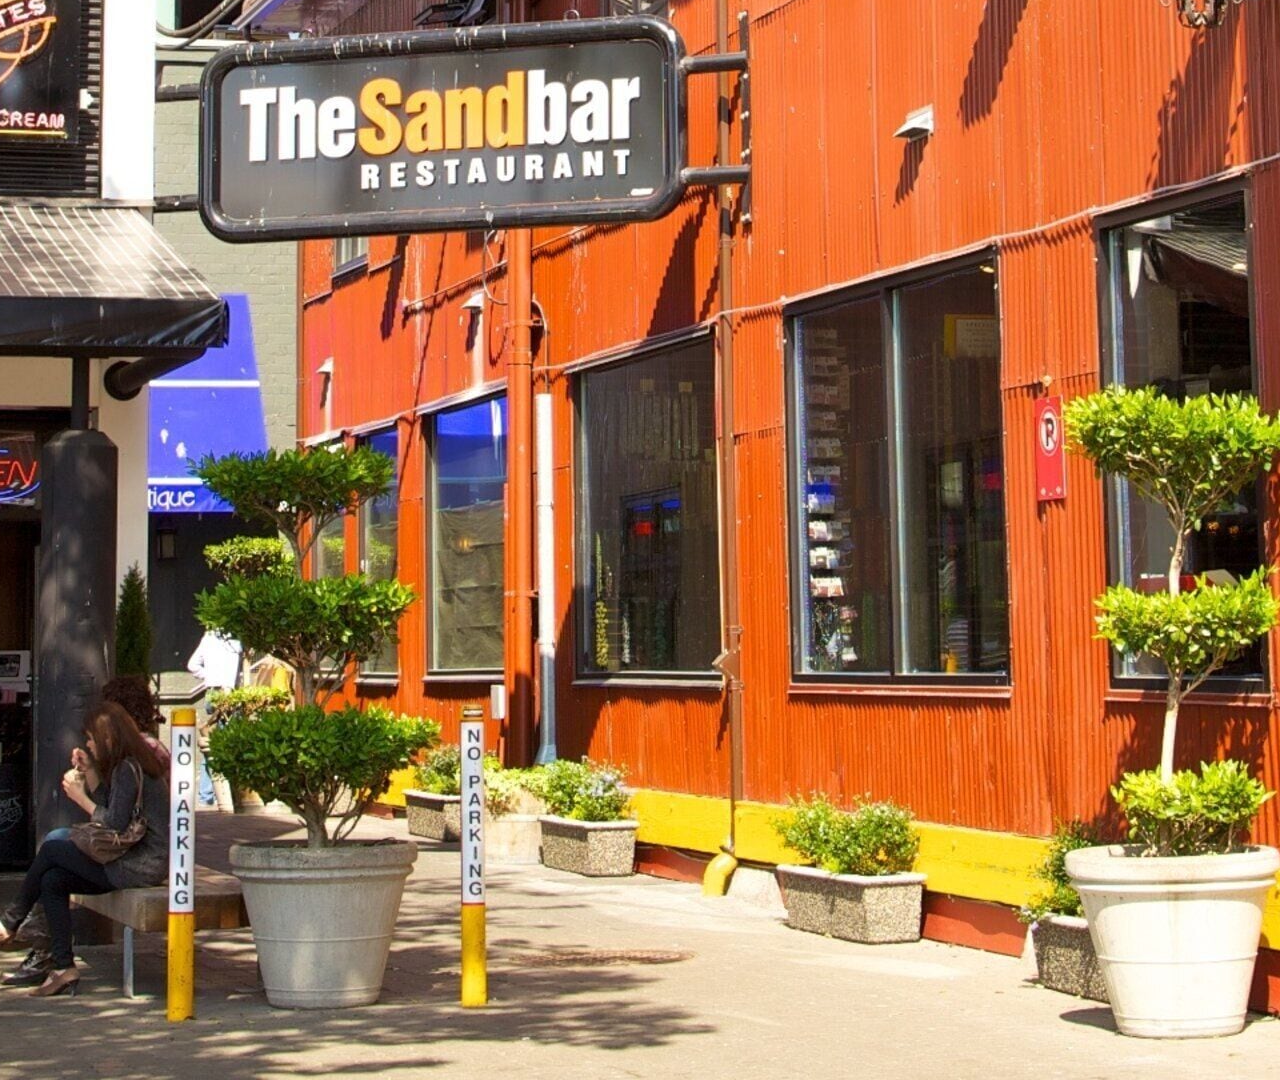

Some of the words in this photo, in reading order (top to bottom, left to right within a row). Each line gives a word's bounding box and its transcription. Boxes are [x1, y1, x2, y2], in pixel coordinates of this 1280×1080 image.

[360, 149, 631, 190] RESTAURANT
[177, 733, 191, 766] NO
[467, 729, 481, 761] NO
[174, 780, 190, 905] PARKING
[468, 775, 482, 896] PARKING
